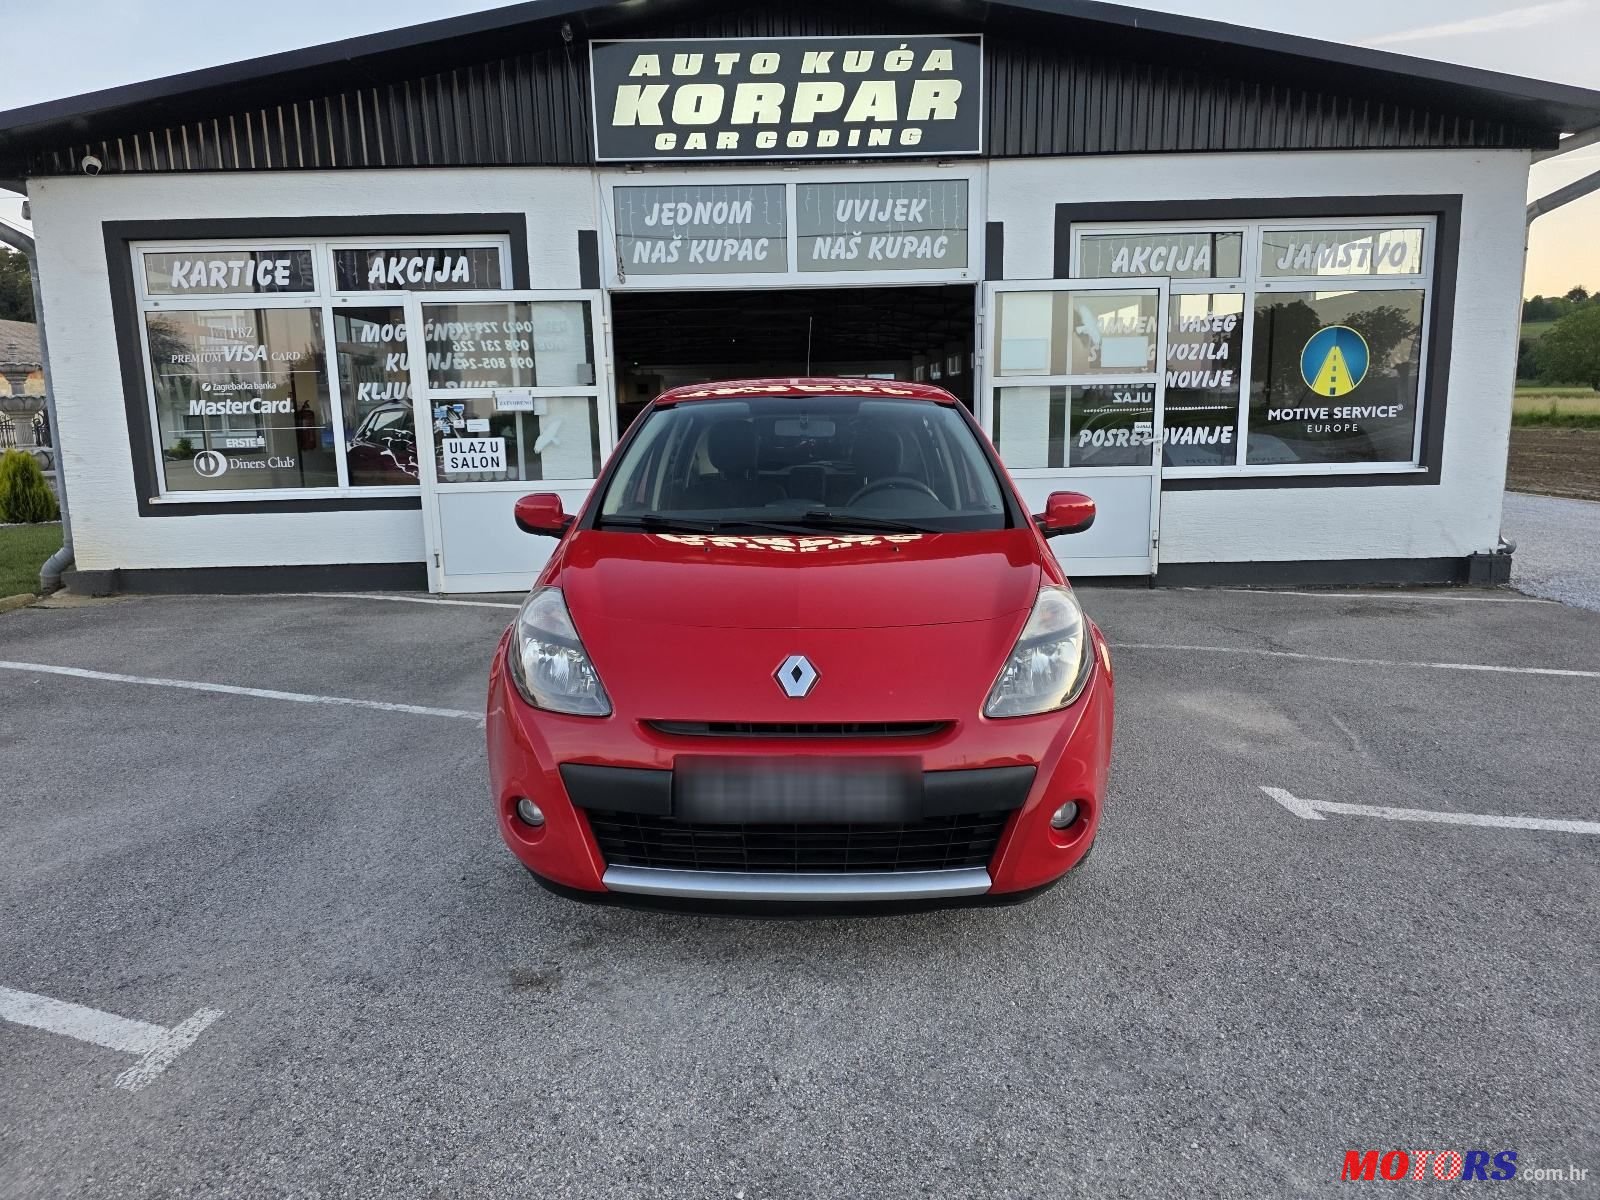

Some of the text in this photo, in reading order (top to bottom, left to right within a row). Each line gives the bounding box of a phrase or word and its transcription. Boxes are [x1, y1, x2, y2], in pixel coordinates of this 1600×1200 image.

[629, 44, 954, 77] AUTO KUĆA
[612, 79, 963, 126] KORPAR
[655, 127, 923, 151] CAR CODING
[644, 200, 753, 227] JEDNOM
[836, 197, 928, 224] UVIJEK
[633, 235, 769, 264] NAŠ KUPAC
[812, 231, 949, 261] NAŠ KUPAC
[1276, 240, 1408, 270] JAMSTVO
[368, 255, 470, 286] AKCIJA
[1111, 245, 1211, 274] AKCIJA
[171, 259, 292, 289] KARTICE
[1179, 311, 1237, 333] VAŠEG
[171, 345, 301, 364] PREMIUM VISA CARD
[1166, 342, 1229, 361] VOZILA
[254, 381, 277, 390] banka
[1166, 370, 1234, 388] NOVIJE
[1268, 408, 1329, 421] MOTIVE
[1307, 423, 1358, 433] EUROPE
[226, 438, 257, 448] ERSTE
[449, 441, 499, 454] ULAZ U
[230, 458, 266, 469] Diners
[451, 456, 500, 469] SALON
